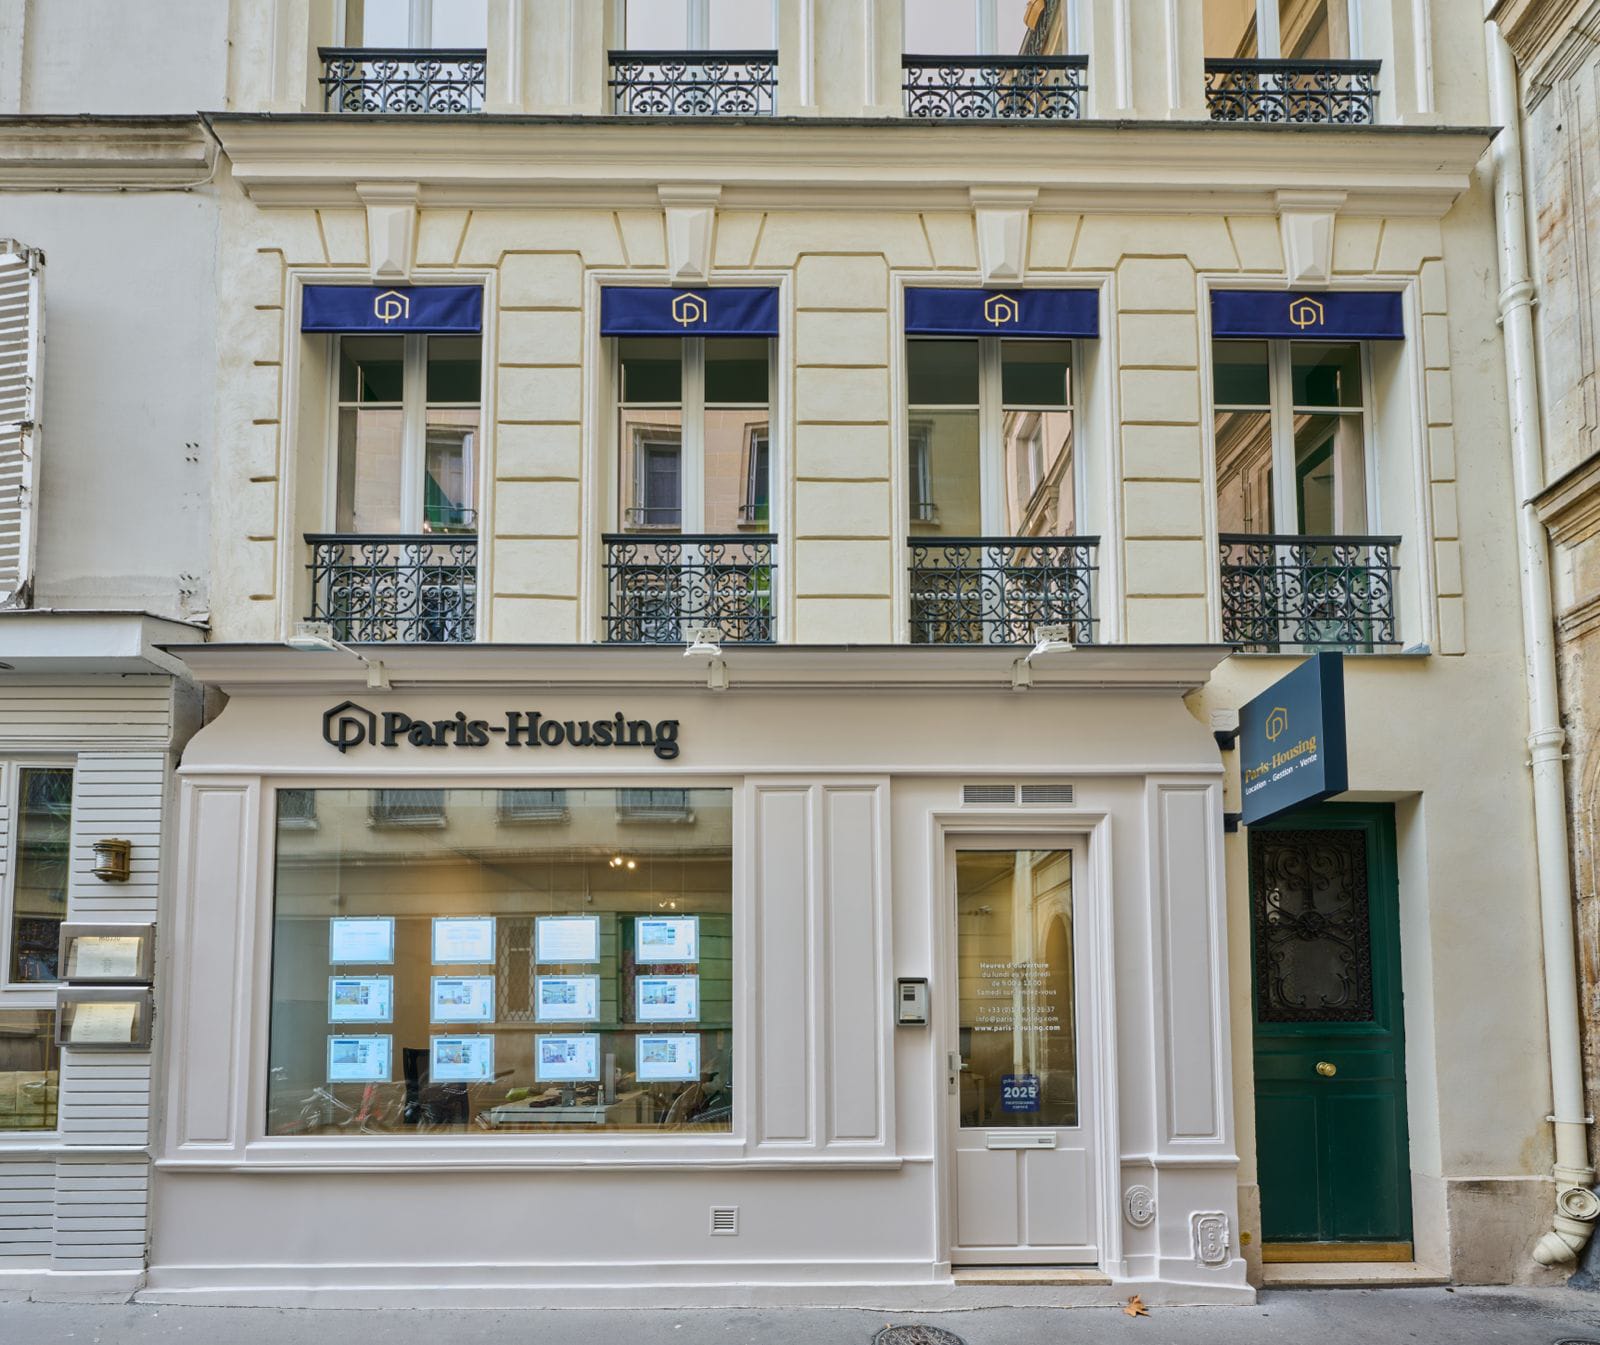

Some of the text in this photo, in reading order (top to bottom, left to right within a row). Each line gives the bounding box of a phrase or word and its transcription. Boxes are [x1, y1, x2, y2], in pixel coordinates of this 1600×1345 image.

[381, 711, 679, 759] Paris-Housing
[1245, 736, 1317, 784] Paris-Housing
[1245, 780, 1267, 795] Location
[1272, 766, 1293, 782] Gestion
[1299, 754, 1317, 767] Vente
[1003, 1086, 1036, 1098] 2025
